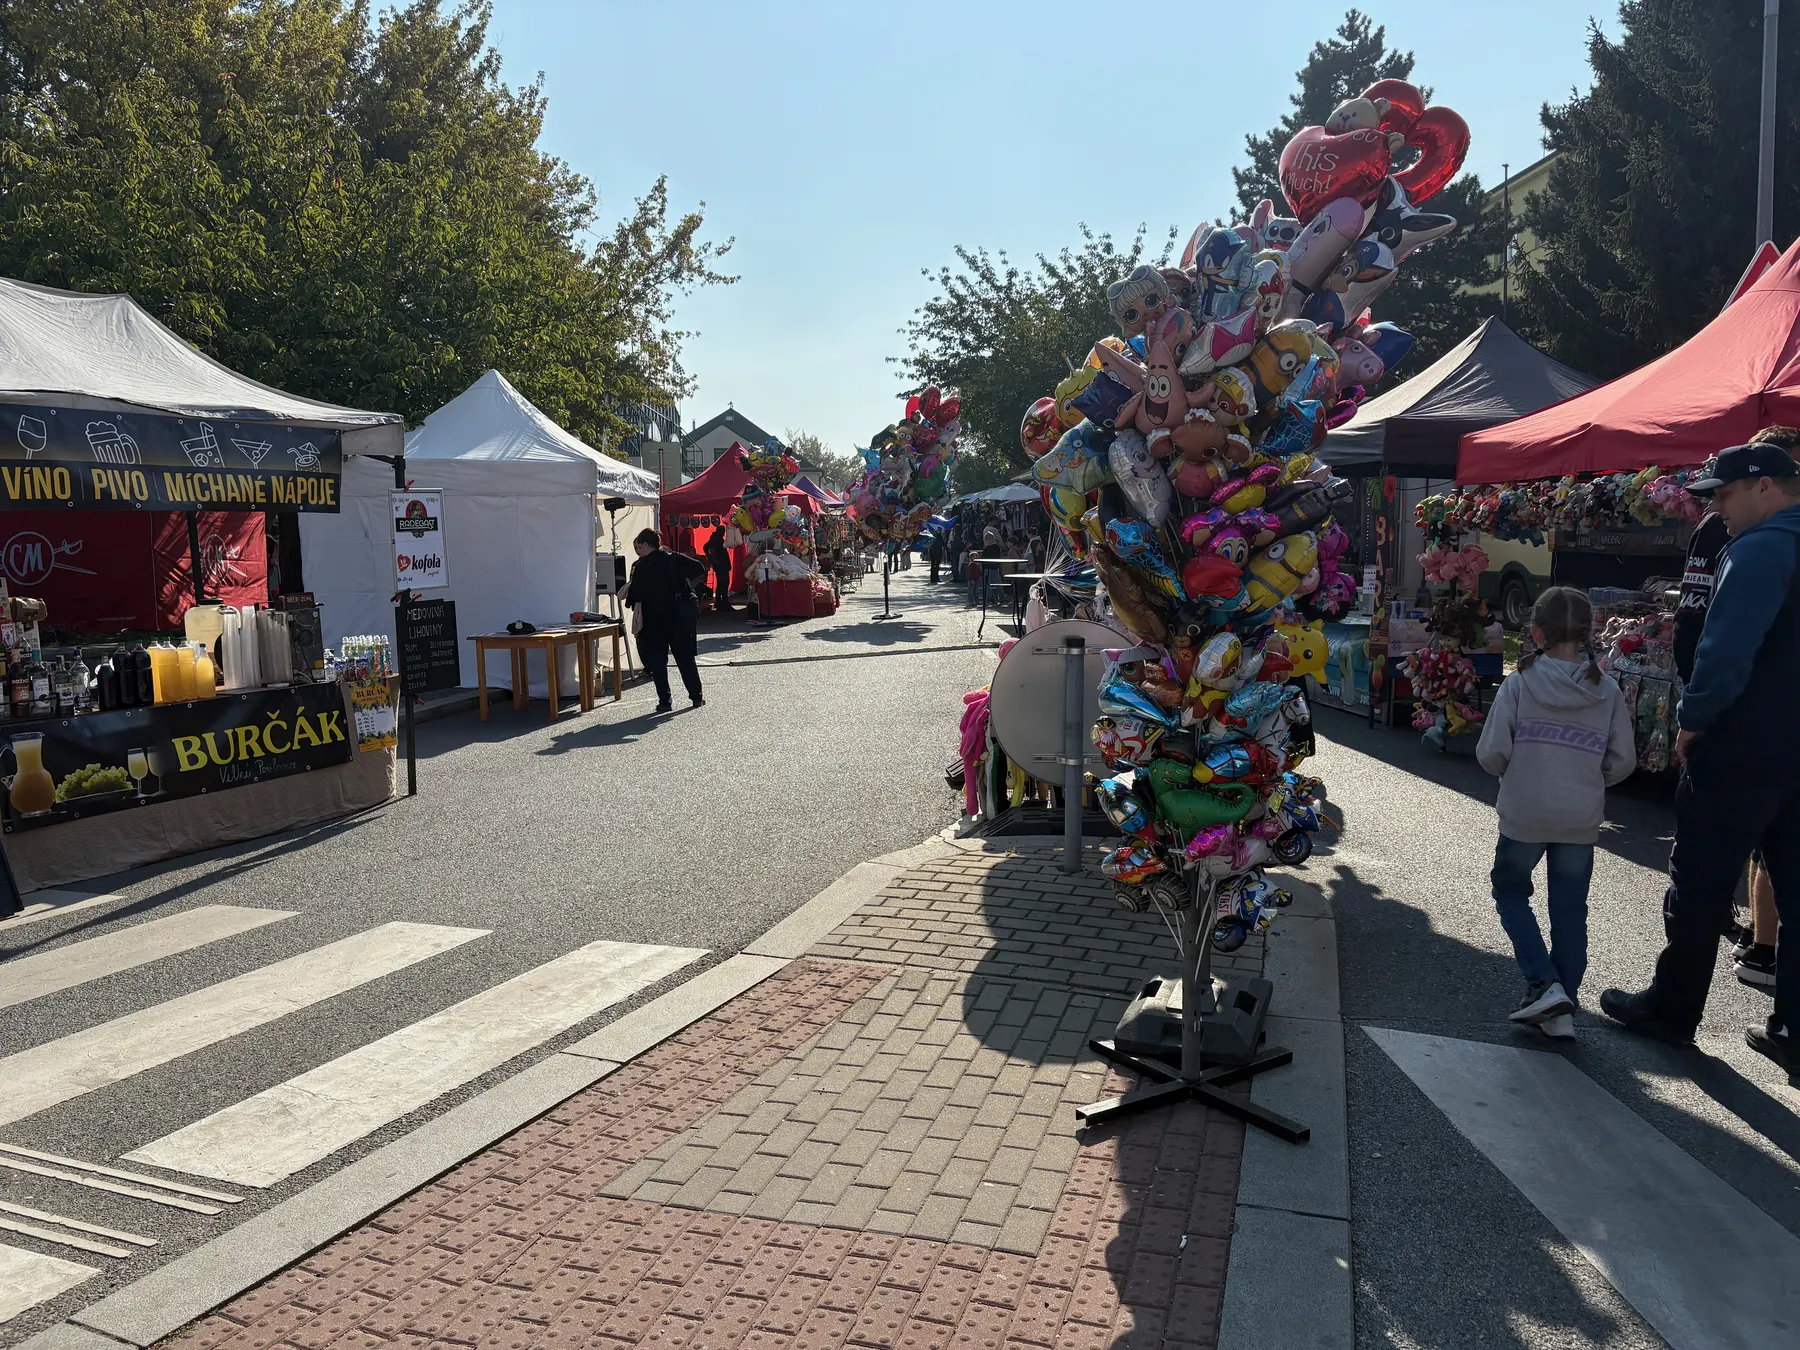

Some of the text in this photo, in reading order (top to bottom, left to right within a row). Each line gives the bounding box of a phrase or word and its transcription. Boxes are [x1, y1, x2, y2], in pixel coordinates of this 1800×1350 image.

[1292, 141, 1340, 172] This
[1, 466, 337, 506] VÍNO PIVO MÍCHANÉ NÁPOJE
[399, 519, 436, 531] RADEGAST
[9, 542, 46, 578] CM
[412, 553, 441, 573] kofola
[1688, 556, 1708, 568] RAW
[1679, 592, 1708, 609] LACK
[406, 605, 445, 621] MEDOVINA
[408, 624, 443, 640] LIHOVINY
[404, 643, 418, 653] RUM
[171, 705, 346, 773] BURČÁK
